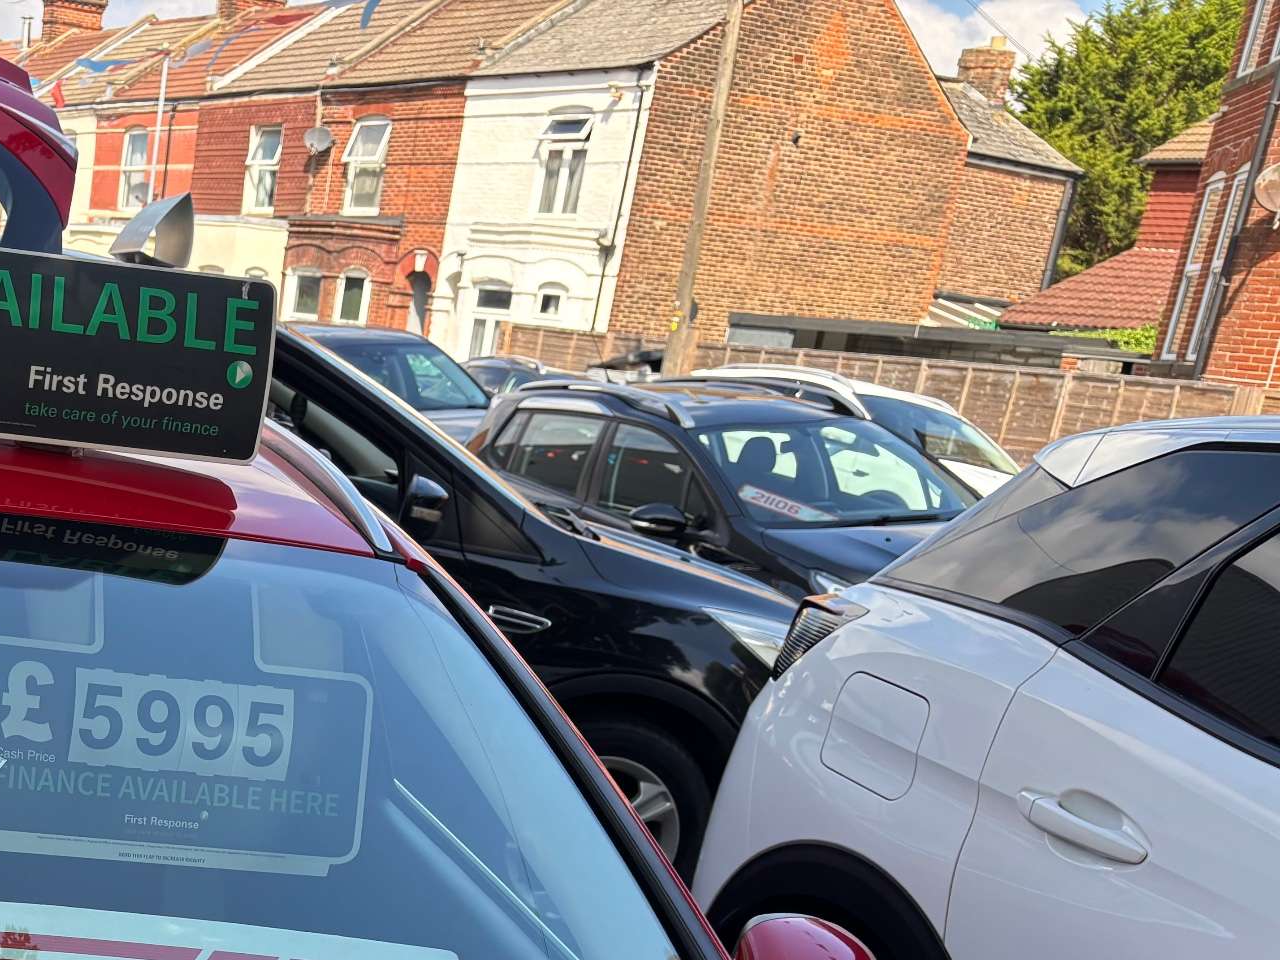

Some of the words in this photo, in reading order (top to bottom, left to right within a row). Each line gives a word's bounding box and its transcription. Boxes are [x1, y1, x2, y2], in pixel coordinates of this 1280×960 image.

[28, 365, 87, 396] First
[96, 372, 224, 411] Response
[24, 401, 58, 418] take
[62, 408, 96, 423] care
[101, 410, 120, 425] of
[121, 414, 158, 431] your
[161, 416, 219, 437] finance
[1, 660, 286, 769] £5995
[27, 749, 56, 763] Price
[120, 773, 262, 811] AVAILABLE
[269, 789, 340, 818] HERE
[124, 814, 147, 825] First
[150, 816, 199, 829] Response
